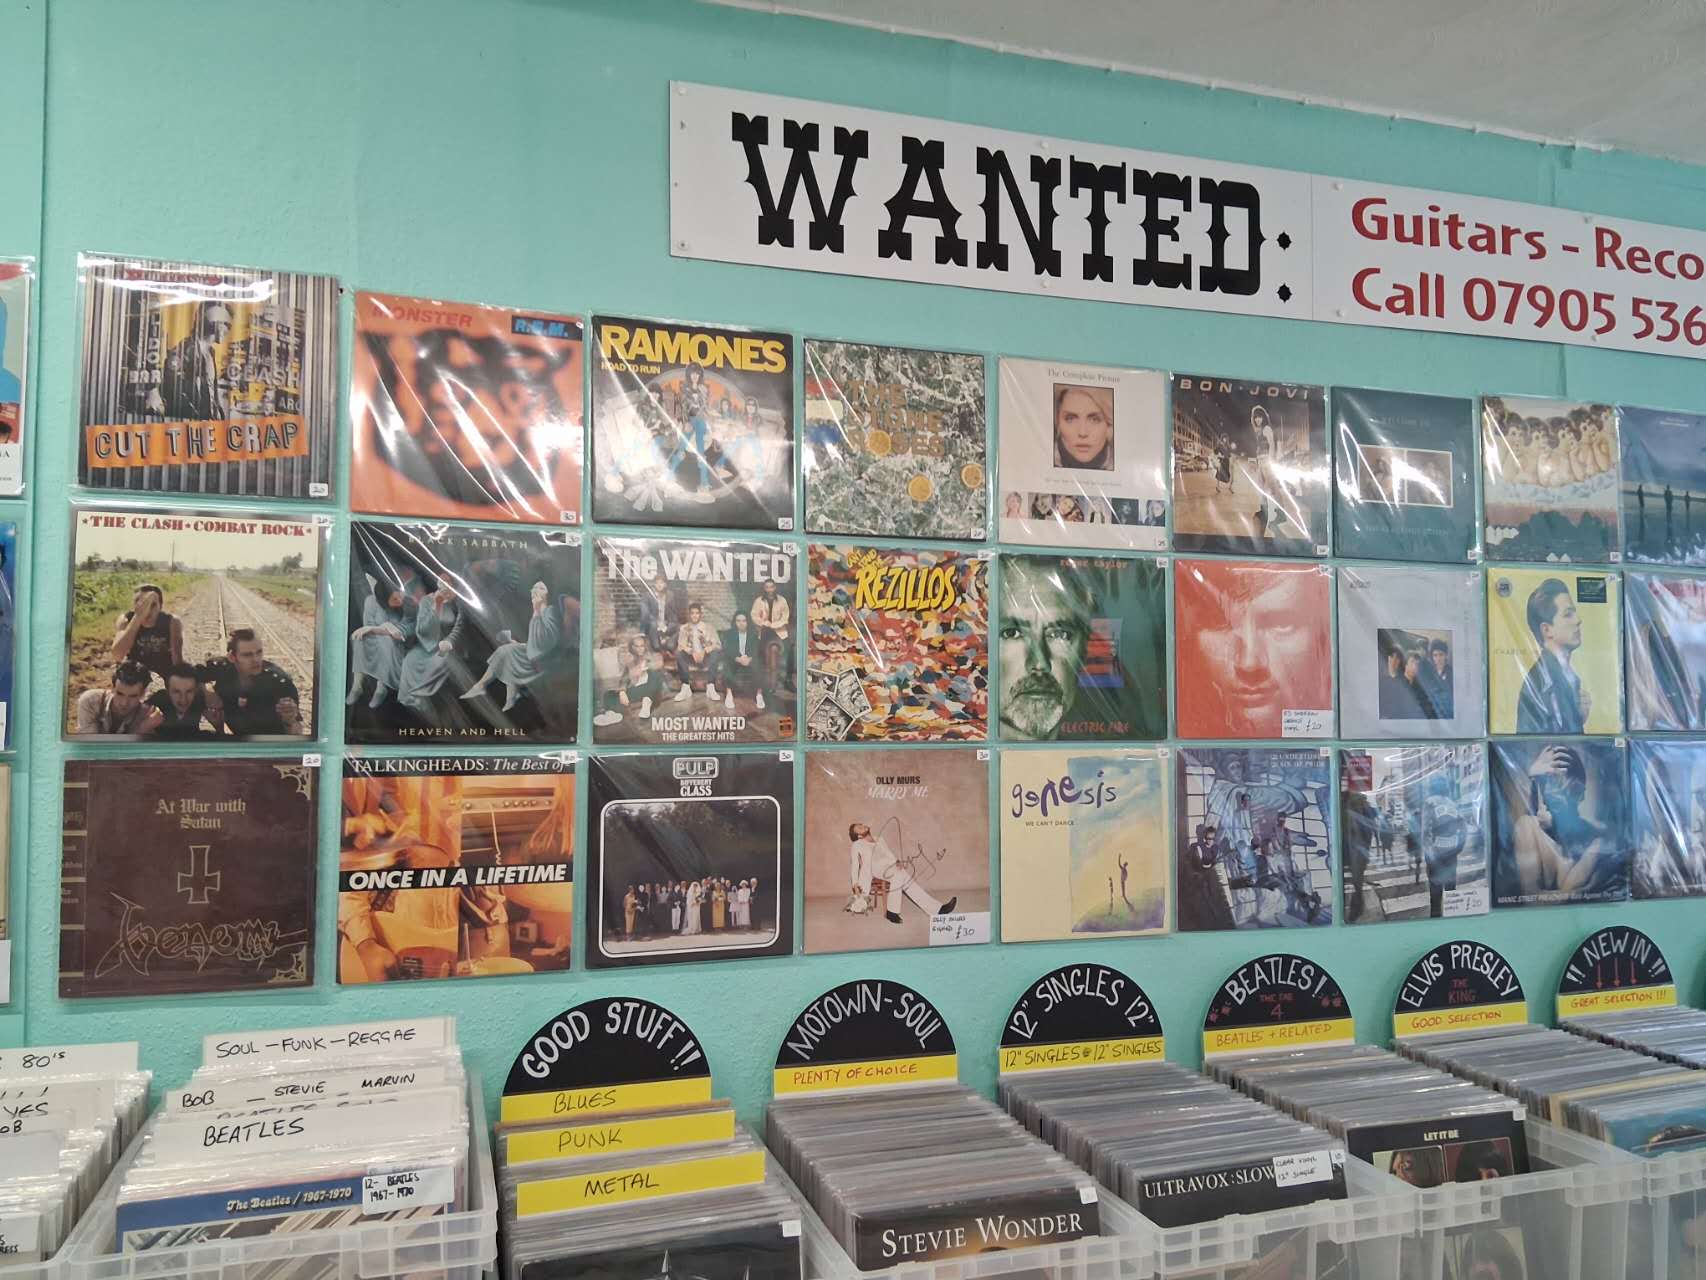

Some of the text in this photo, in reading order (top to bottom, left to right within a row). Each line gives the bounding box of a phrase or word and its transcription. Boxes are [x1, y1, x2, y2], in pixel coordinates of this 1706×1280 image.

[732, 111, 1292, 303] WANTED:
[1351, 197, 1547, 260] Guitars
[1561, 244, 1580, 254] -
[1352, 267, 1706, 346] Call 07905 536
[600, 324, 787, 374] RAMONES
[639, 364, 661, 375] RUIN
[1179, 378, 1308, 400] BON JOVI
[95, 421, 299, 459] CUT THE CRAP
[90, 515, 305, 536] THE CLASH COMBAT ROCK
[408, 536, 529, 550] BLACK SABBATH
[602, 549, 791, 584] The WANTED
[855, 564, 957, 612] REZILLOS
[399, 727, 527, 736] HEAVEN AND HELL
[652, 716, 746, 731] MOST WANTED
[662, 731, 735, 741] THE GREATEST HITS
[493, 758, 518, 771] The
[521, 758, 549, 770] Best
[676, 760, 716, 776] PULP
[680, 785, 713, 798] CLASS
[876, 776, 921, 785] OLLY MURS
[1011, 769, 1117, 818] genesis
[156, 798, 247, 815] At War with
[180, 815, 222, 830] Satan
[349, 863, 567, 890] ONCE IN A LIFETIME
[1582, 931, 1630, 968] NEW
[1630, 934, 1652, 965] IN
[1401, 943, 1519, 1008] ELVIS PRESLEY
[1035, 967, 1125, 1013] SINGLES
[1570, 996, 1601, 1009] GREAT
[1604, 991, 1653, 1005] SELECTION
[1411, 1010, 1502, 1029] GOOD SELECTION
[216, 1041, 260, 1058] SOUL
[281, 1036, 323, 1052] FUNK
[348, 1028, 417, 1048] REGGAE
[522, 1010, 591, 1078] GOOD
[1216, 1030, 1265, 1048] BEATLES
[1279, 1023, 1332, 1038] RELATED
[1025, 1046, 1081, 1066] SINGLES
[1112, 1040, 1163, 1058] SINGLES
[793, 1063, 918, 1085] PLENTY OF CHOICE
[181, 1093, 216, 1109] BOB
[273, 1081, 327, 1097] STEVIE
[361, 1073, 416, 1089] MARVIN
[553, 1089, 617, 1114] BLUES
[3, 1102, 49, 1120] YES
[203, 1117, 305, 1147] BEATLES
[558, 1128, 623, 1152] PUNK
[1424, 1129, 1459, 1142] LET IT BE
[387, 1173, 420, 1187] BEATLES
[584, 1173, 660, 1198] METAL
[226, 1198, 247, 1212] The
[251, 1195, 290, 1209] Beatles
[302, 1187, 352, 1202] 1967-1970
[882, 1212, 1084, 1258] STEVIE WONDER
